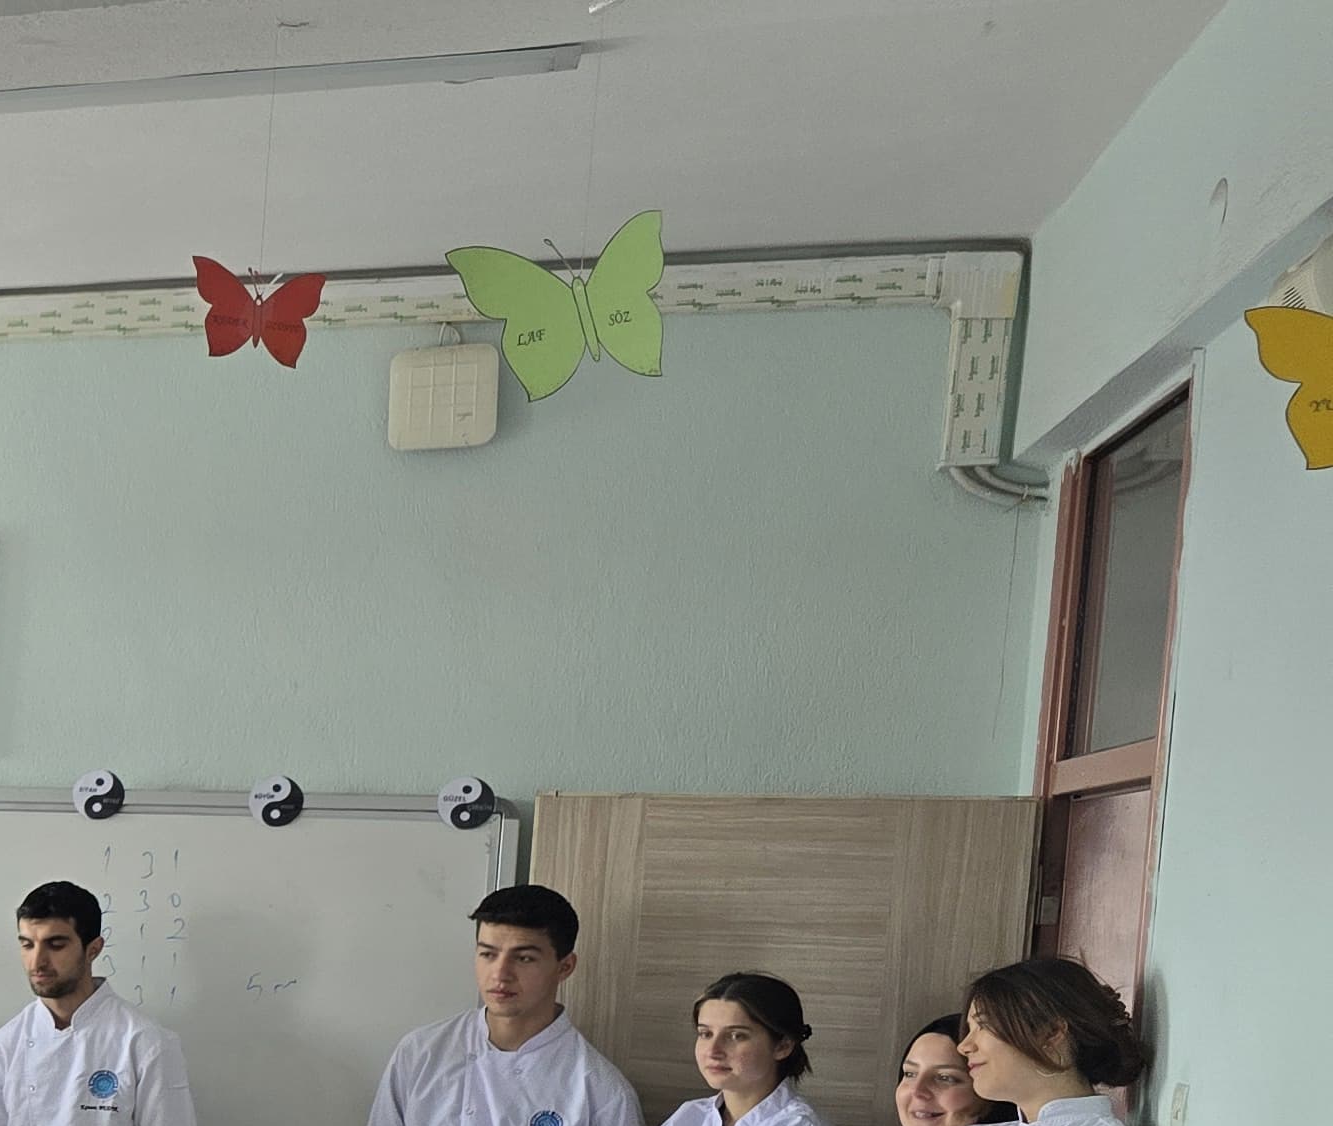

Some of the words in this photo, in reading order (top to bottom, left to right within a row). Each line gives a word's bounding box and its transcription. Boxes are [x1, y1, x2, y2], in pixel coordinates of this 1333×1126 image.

[608, 309, 632, 327] SÖZ
[517, 328, 546, 347] LAF
[443, 795, 467, 803] GÜZEL
[141, 851, 154, 879] 3
[101, 893, 117, 914] 2
[135, 890, 150, 912] 3
[170, 892, 181, 908] 0
[101, 926, 116, 947] 2
[166, 918, 187, 940] 2
[102, 955, 116, 977] 3
